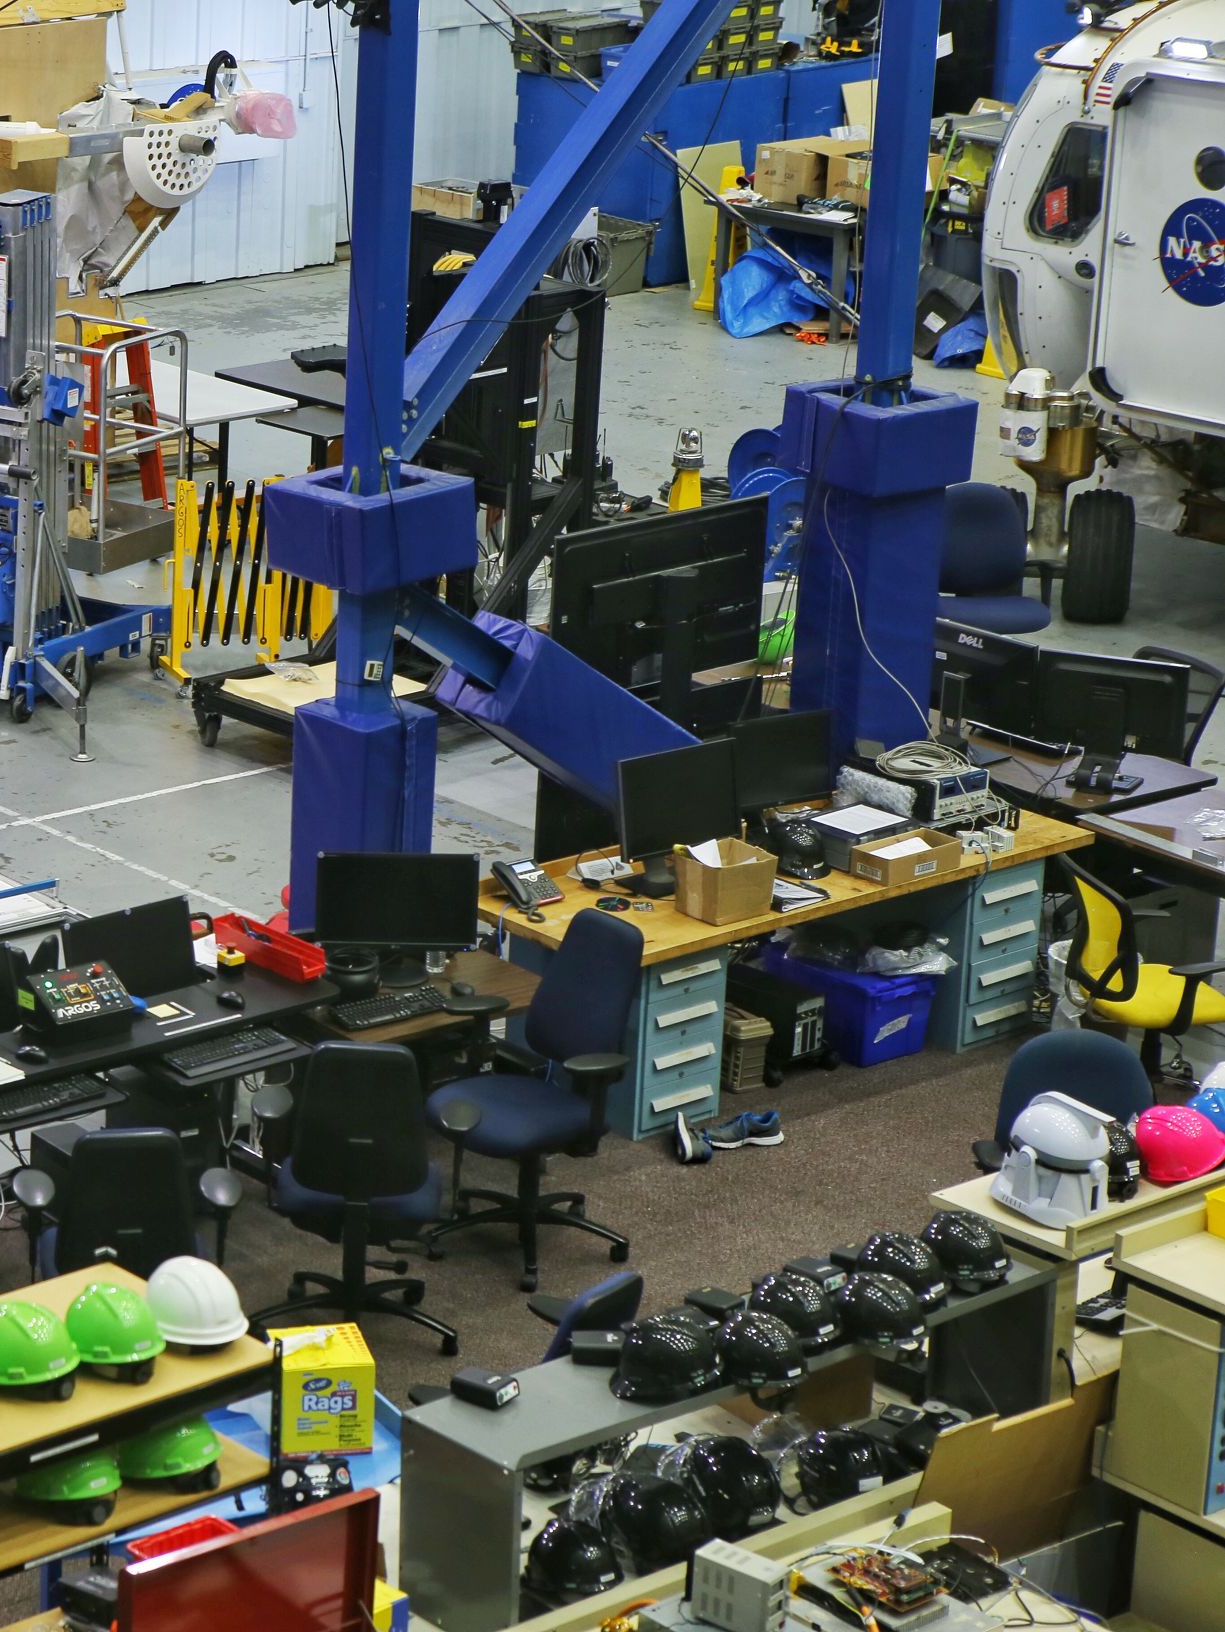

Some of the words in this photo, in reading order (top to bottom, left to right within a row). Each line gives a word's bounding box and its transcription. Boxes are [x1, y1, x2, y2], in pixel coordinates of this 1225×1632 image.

[177, 482, 186, 538] ARGOS
[958, 632, 984, 649] DELL
[57, 1001, 101, 1018] ARGOS
[303, 1393, 354, 1414] Rags
